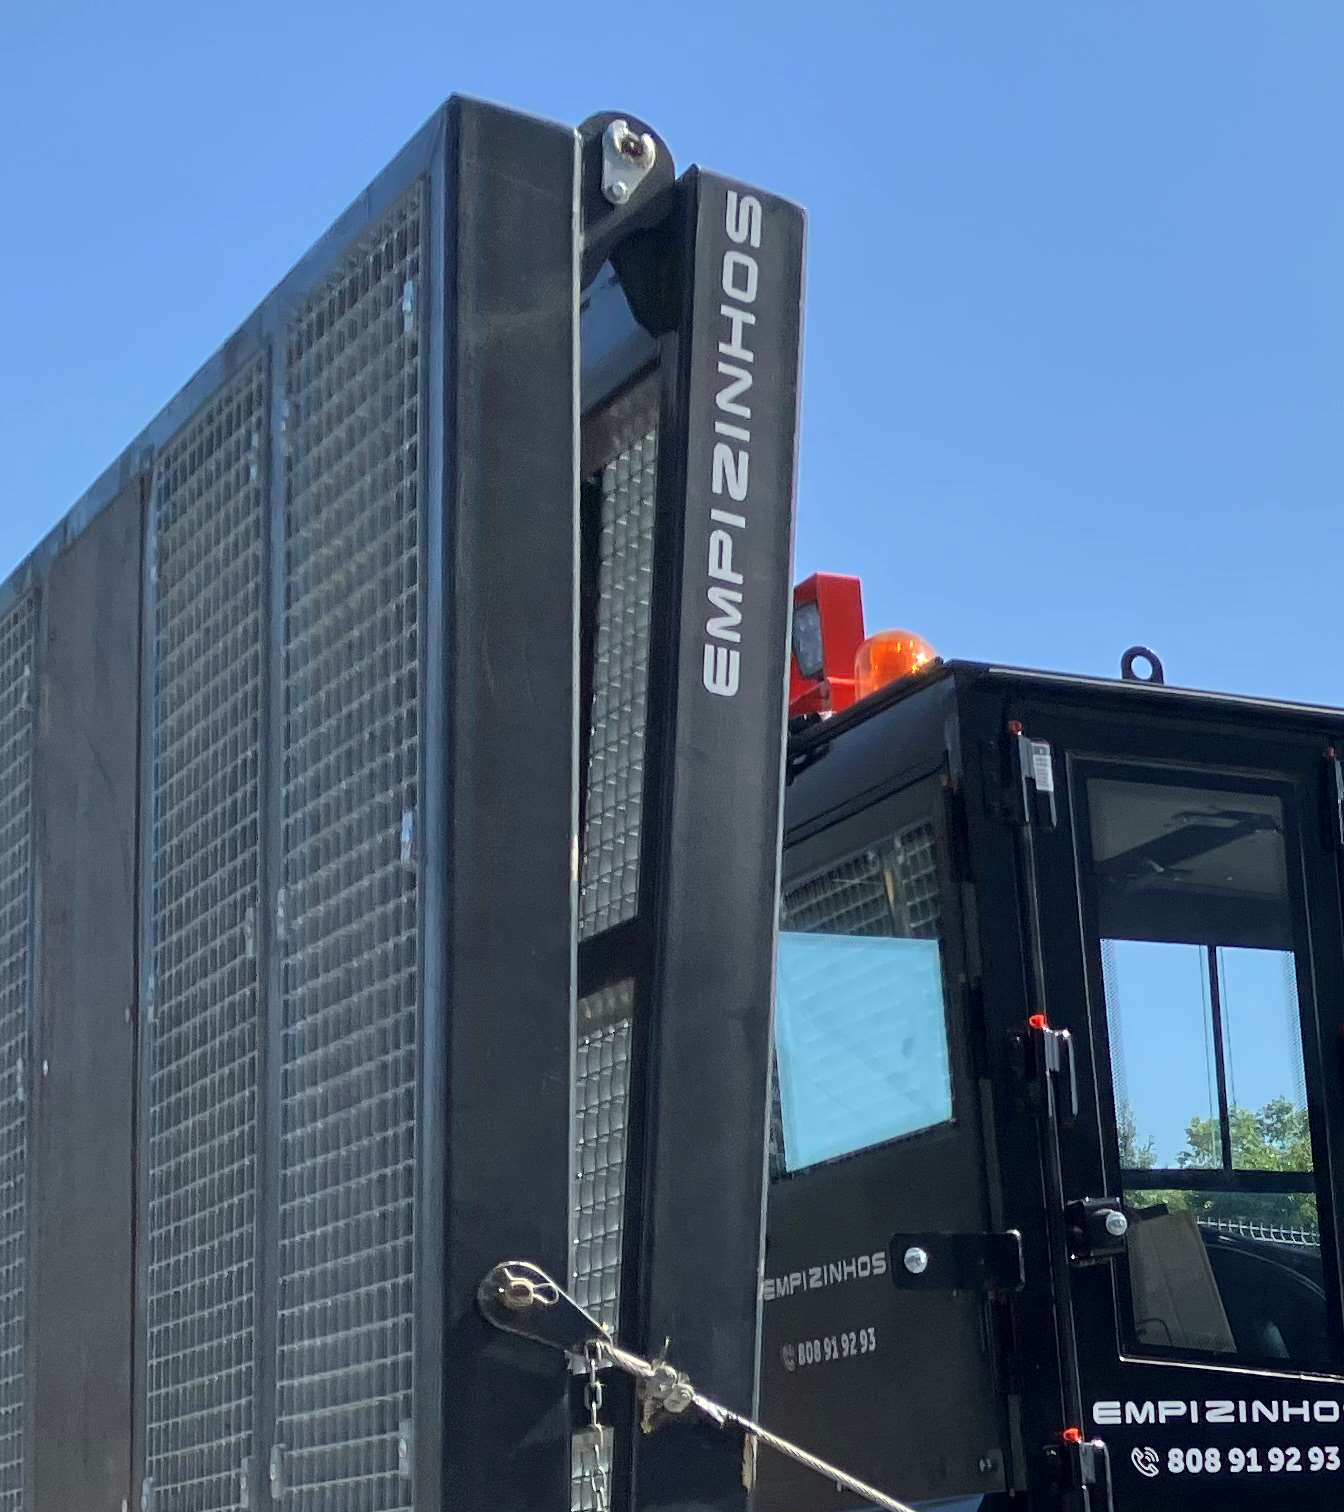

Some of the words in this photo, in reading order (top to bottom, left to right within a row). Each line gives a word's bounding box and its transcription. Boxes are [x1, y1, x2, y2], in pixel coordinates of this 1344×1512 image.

[703, 190, 762, 697] EMPIZINHOS
[763, 1251, 887, 1301] EMPIZINHOS
[798, 1340, 822, 1366] 808
[823, 1336, 839, 1361] 91
[841, 1332, 857, 1357] 92
[859, 1327, 876, 1353] 93
[1167, 1448, 1222, 1474] 808
[1228, 1447, 1263, 1473] 91
[1267, 1447, 1302, 1472] 92
[1308, 1446, 1341, 1472] 93
